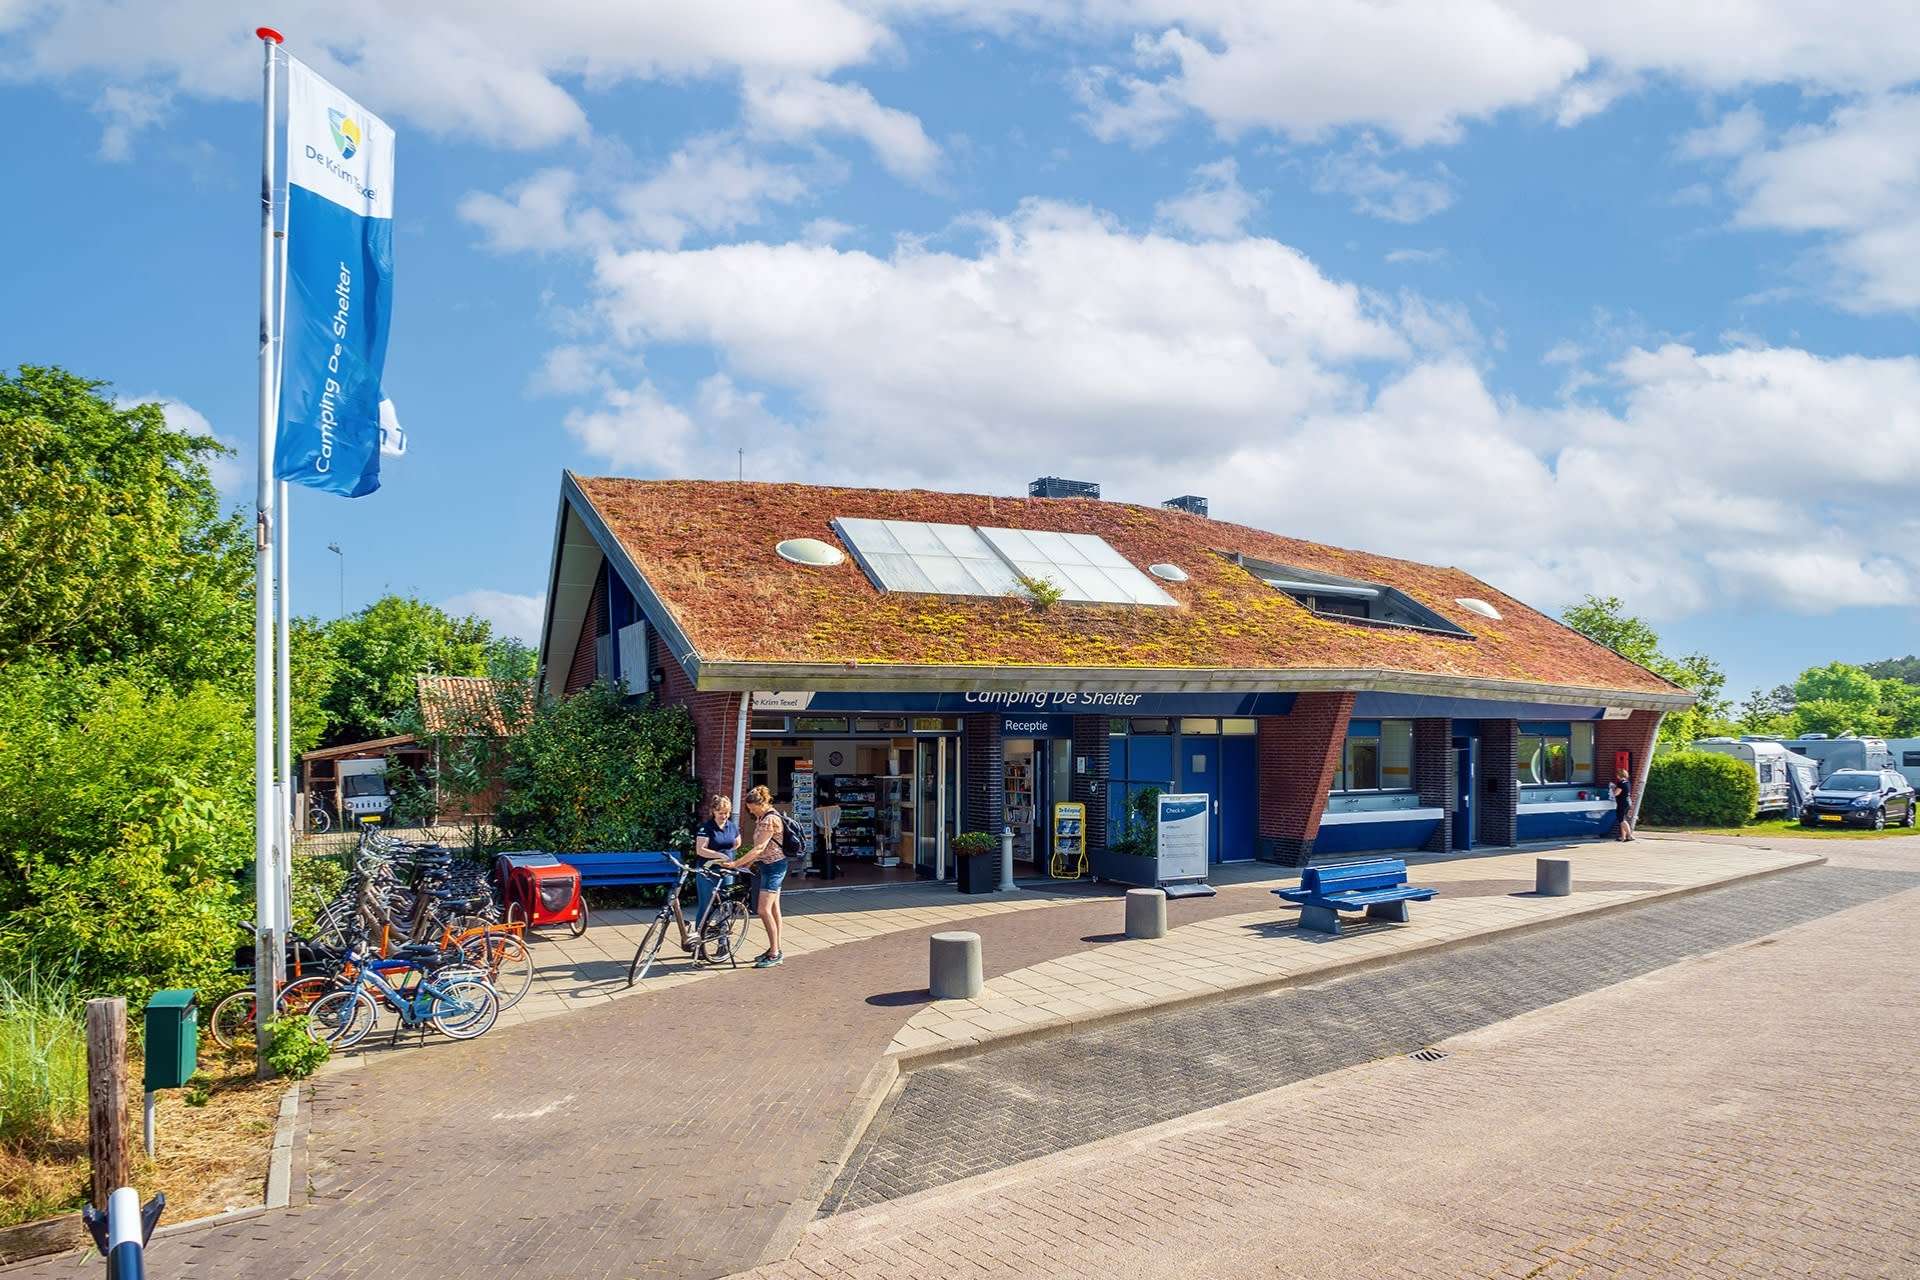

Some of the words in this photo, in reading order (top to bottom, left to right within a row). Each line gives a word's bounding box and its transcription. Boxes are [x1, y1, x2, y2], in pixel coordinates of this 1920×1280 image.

[305, 144, 324, 165] De
[326, 156, 352, 184] Krim
[334, 262, 351, 340] Shelter
[328, 343, 343, 374] De
[316, 378, 340, 473] Camping
[780, 699, 798, 707] Texel
[965, 691, 1047, 707] Camping
[1052, 691, 1077, 704] De
[1080, 691, 1141, 705] Shelter
[1005, 720, 1048, 733] Receptie
